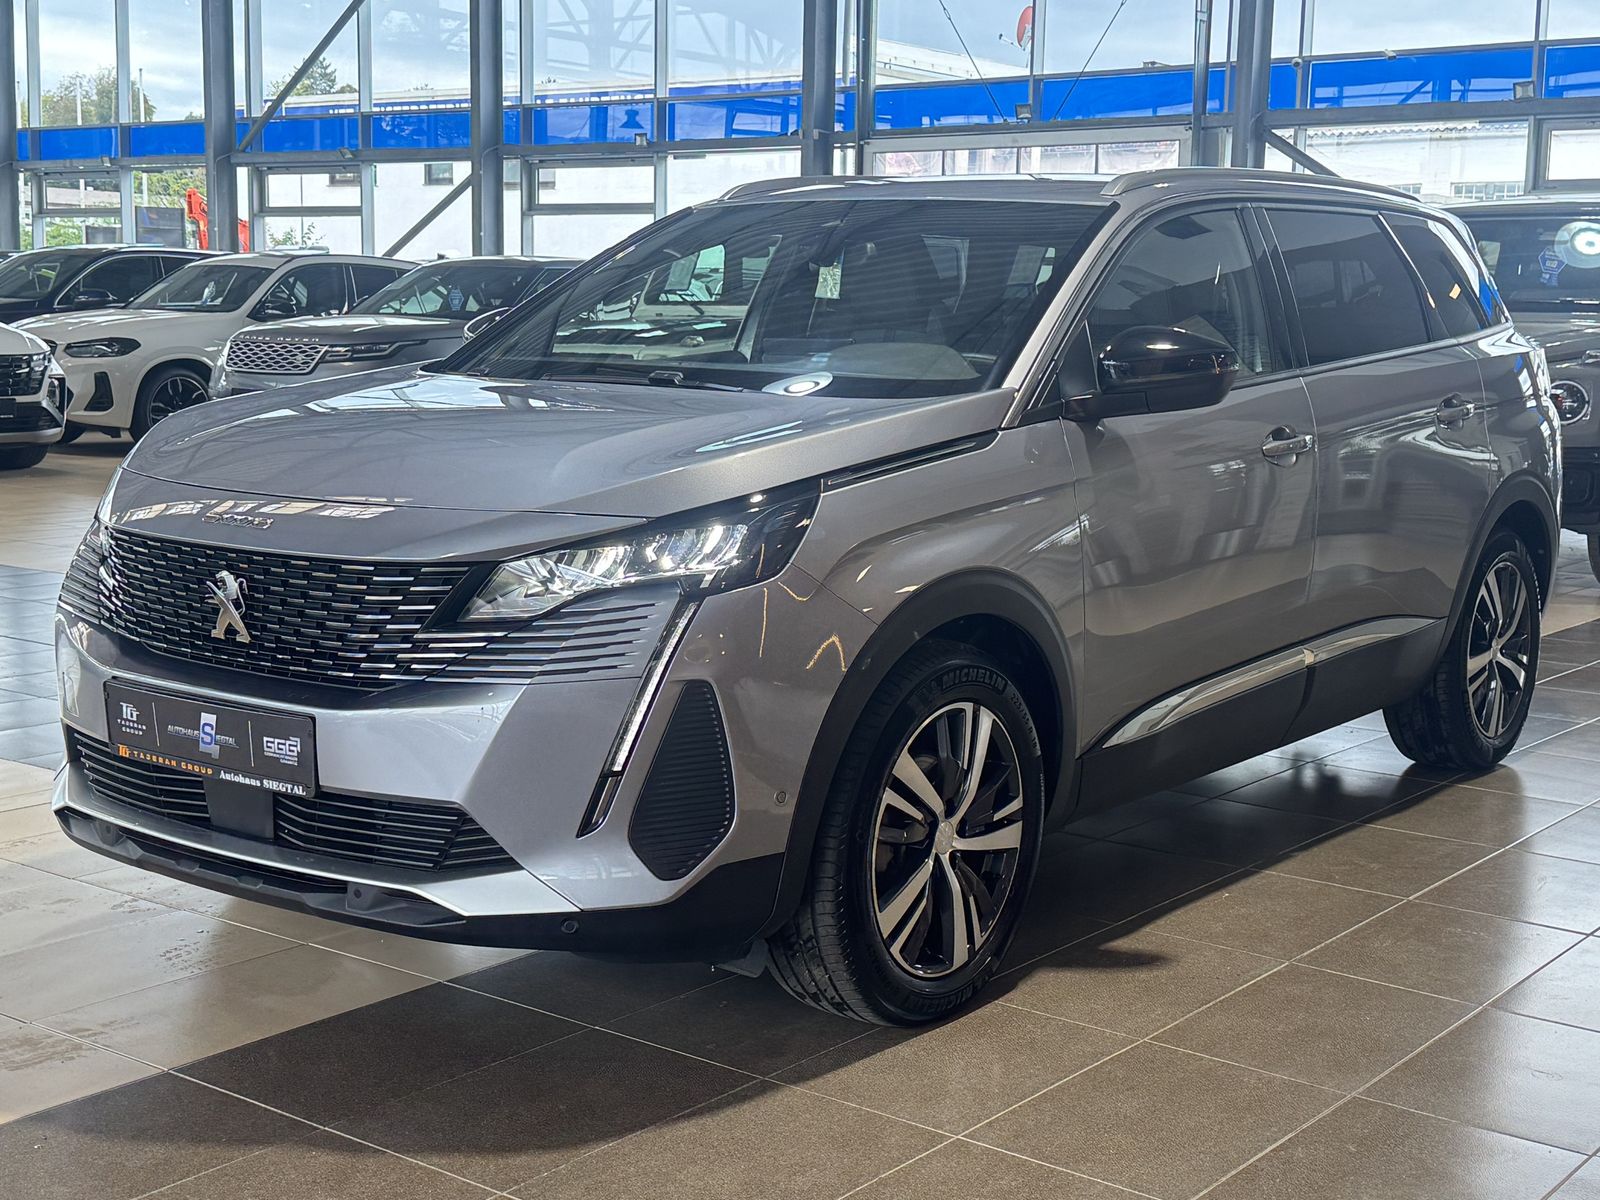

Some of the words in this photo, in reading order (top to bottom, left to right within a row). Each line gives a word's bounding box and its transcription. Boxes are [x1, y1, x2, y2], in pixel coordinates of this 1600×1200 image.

[942, 668, 1006, 691] MICHELIN
[167, 725, 200, 738] AUTOHAUS
[181, 762, 213, 775] GROUP
[220, 770, 261, 787] Autohaus
[262, 779, 306, 796] SIEGTAL
